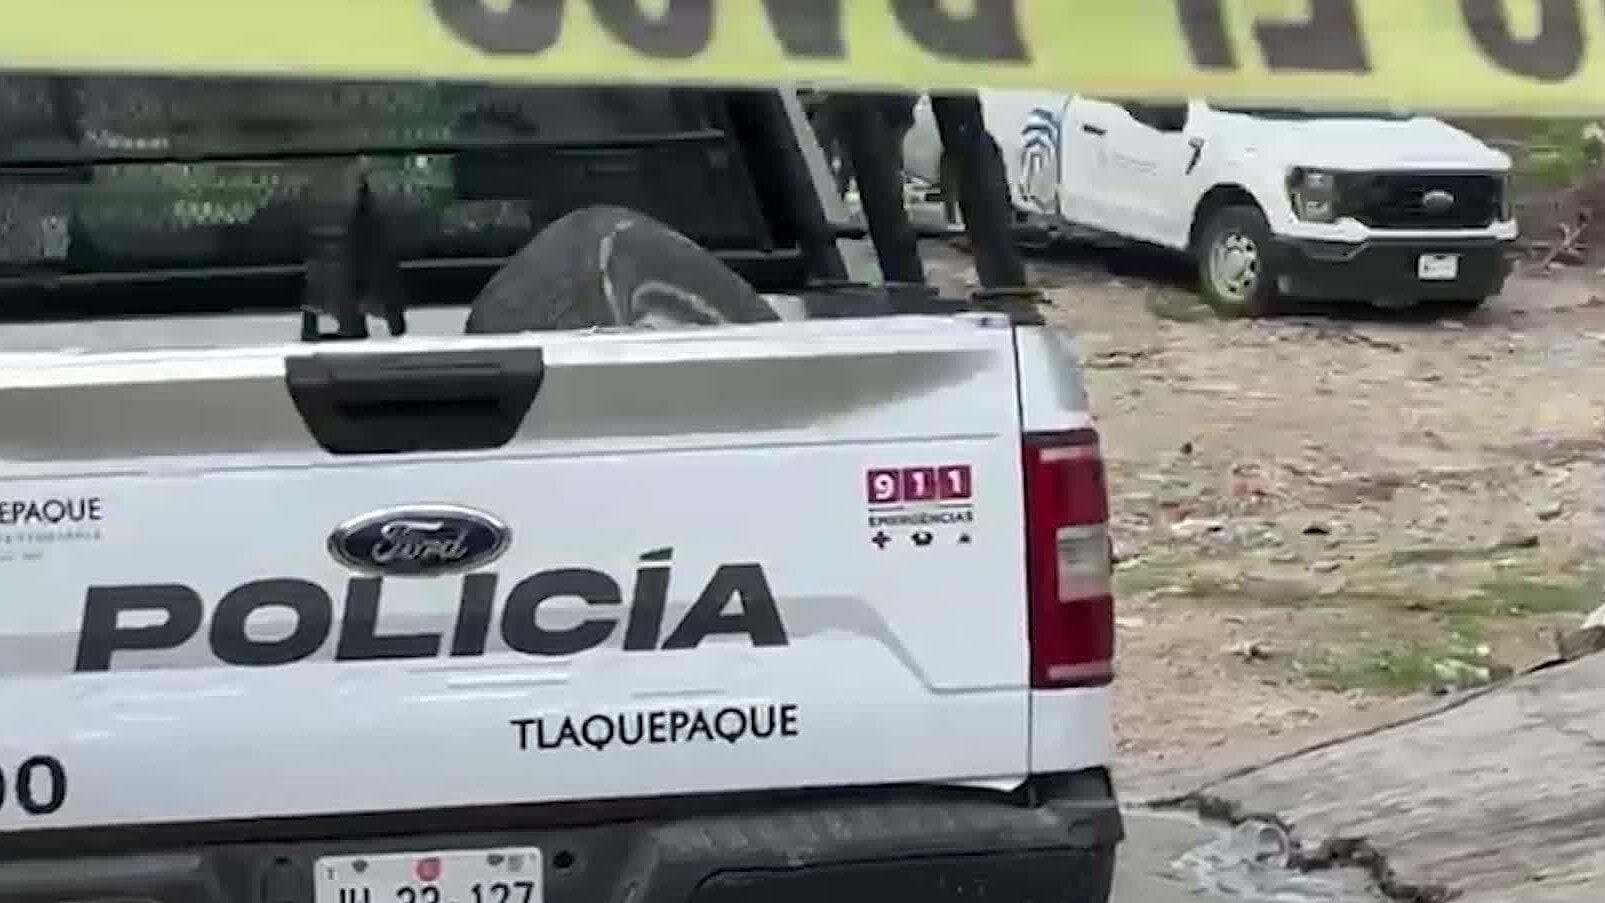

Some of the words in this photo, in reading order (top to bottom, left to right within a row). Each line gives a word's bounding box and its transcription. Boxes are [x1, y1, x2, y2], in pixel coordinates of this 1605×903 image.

[872, 469, 964, 500] 911
[371, 520, 469, 563] Ford
[74, 547, 789, 672] POLICÍA
[510, 704, 799, 751] TLAQUEPAQUE
[0, 754, 67, 815] 0
